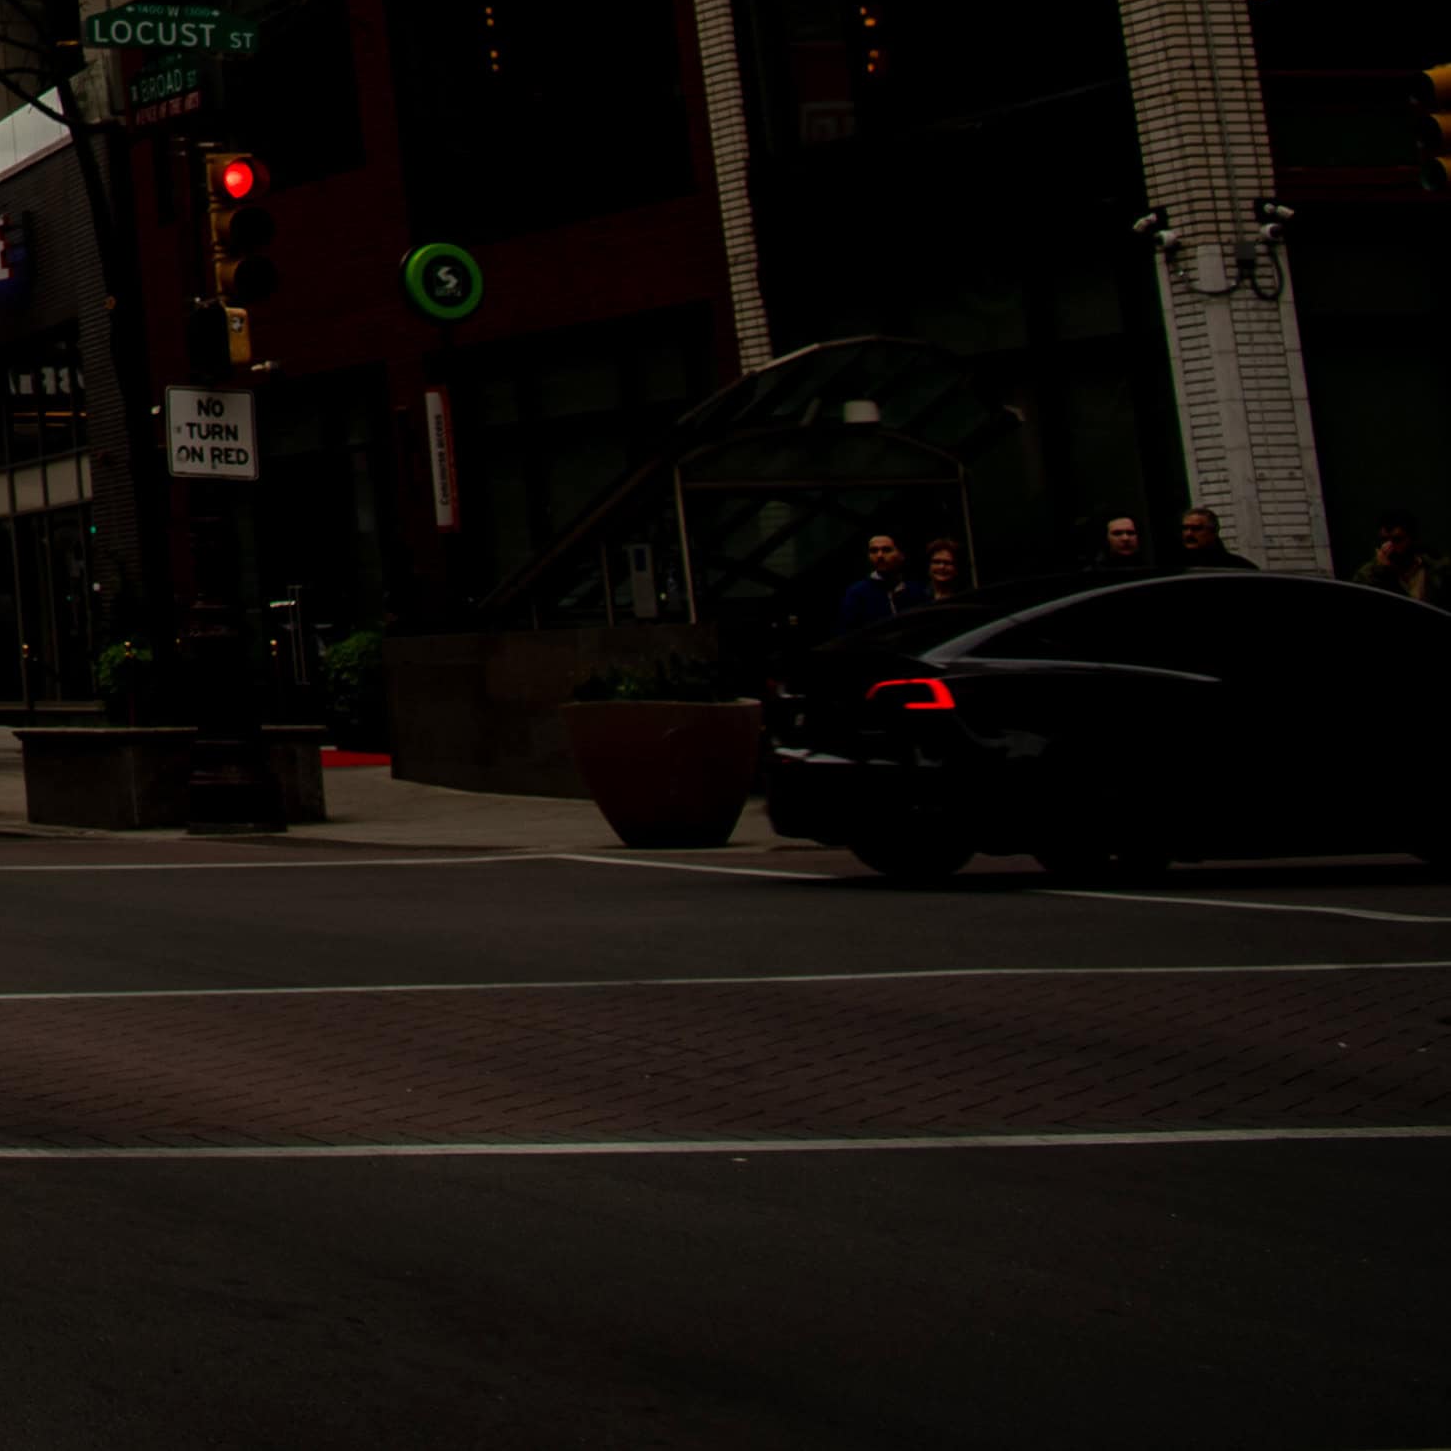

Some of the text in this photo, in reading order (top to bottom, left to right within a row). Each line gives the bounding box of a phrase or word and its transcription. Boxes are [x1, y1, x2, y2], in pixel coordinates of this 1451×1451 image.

[93, 19, 255, 50] LOCUST ST
[141, 68, 183, 104] BROAD
[197, 399, 223, 417] NO
[187, 422, 238, 442] TURN
[176, 445, 249, 465] ON RED
